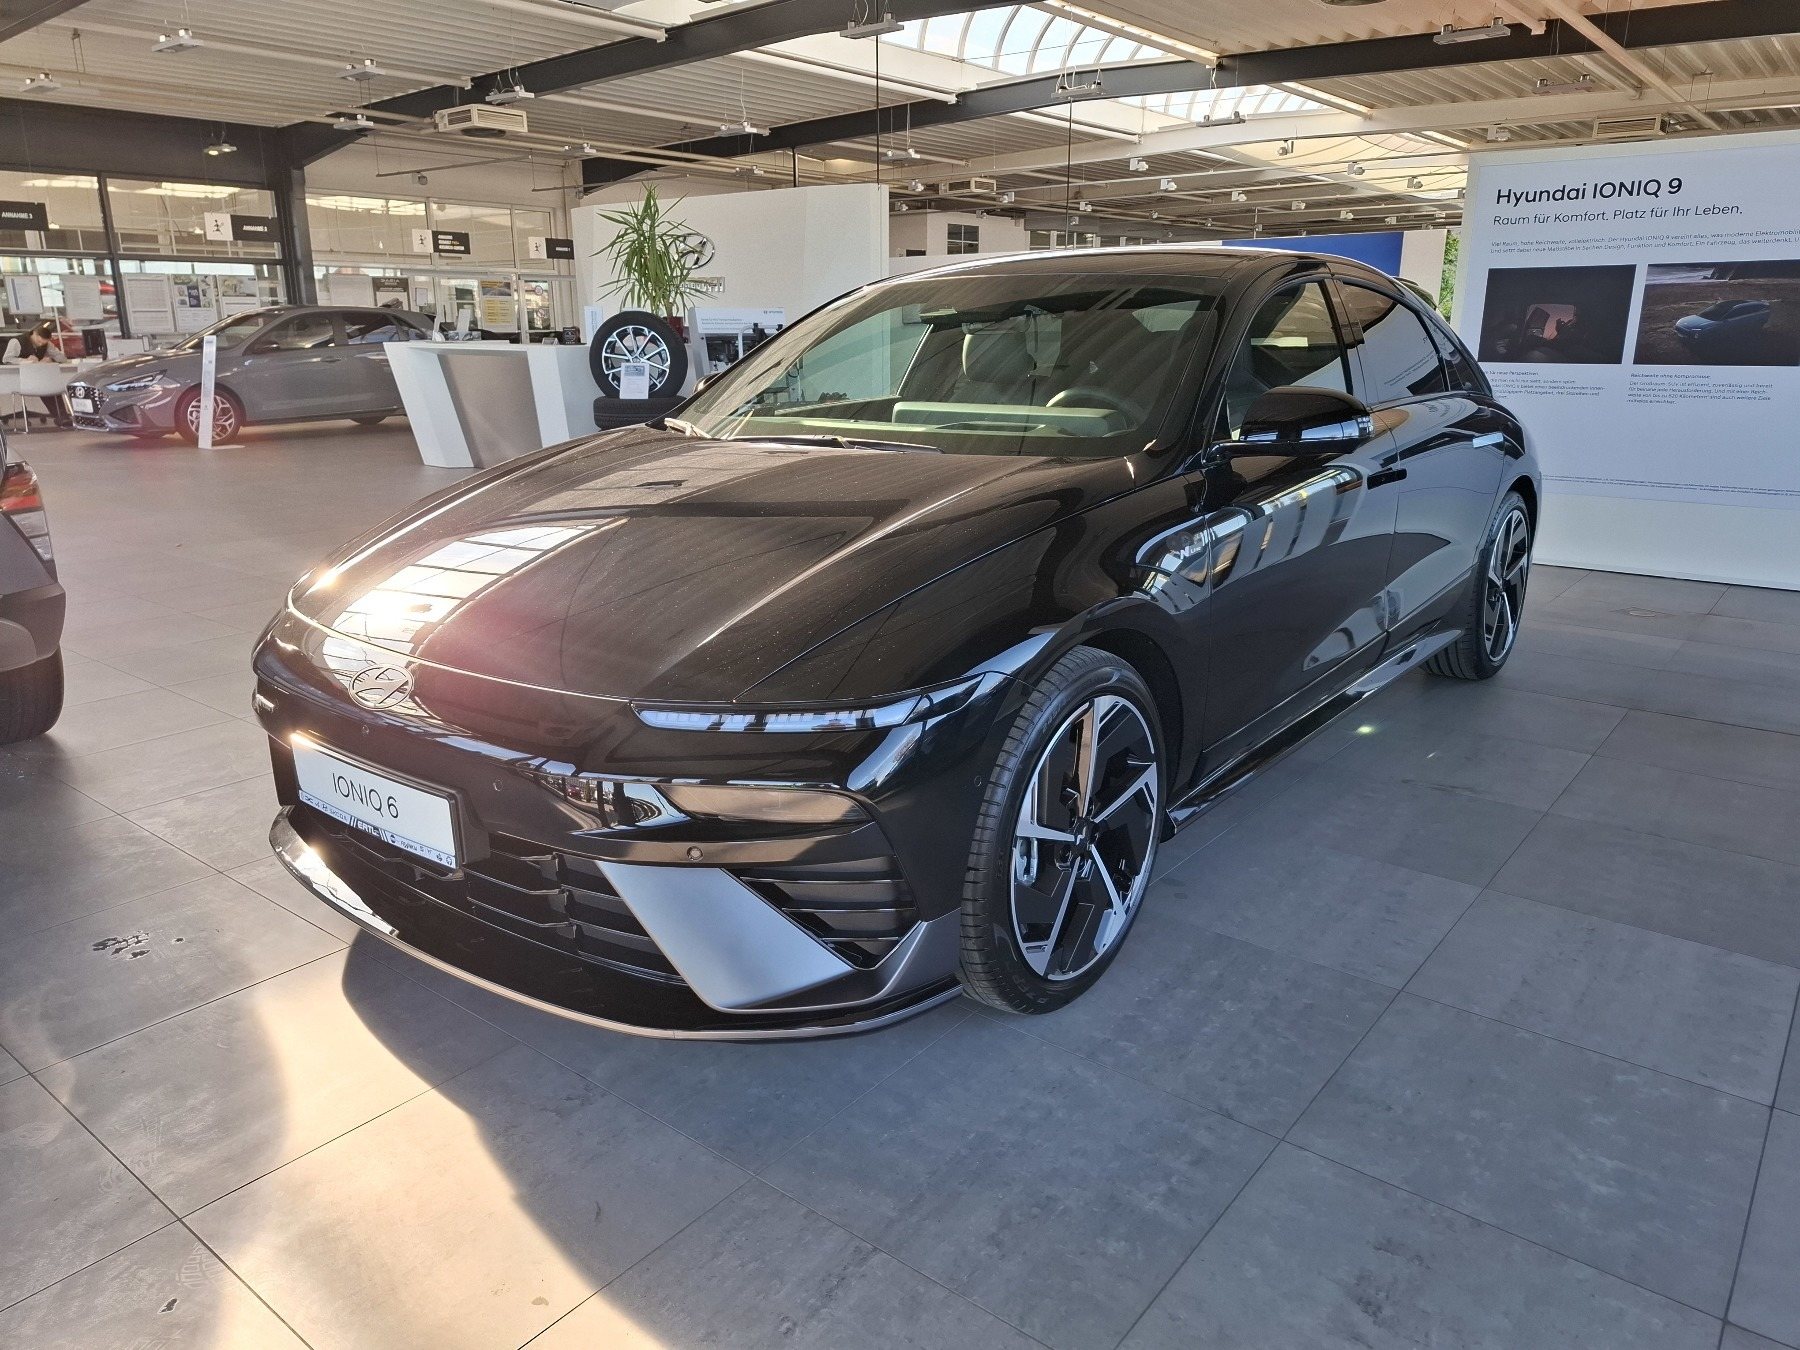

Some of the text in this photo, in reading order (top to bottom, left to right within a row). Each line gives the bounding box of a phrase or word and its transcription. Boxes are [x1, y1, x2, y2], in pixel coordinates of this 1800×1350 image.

[1496, 177, 1683, 207] Hyundai IONIQ 9
[1493, 204, 1743, 226] Raum für Komfort. Platz für Ihr Leben.
[332, 772, 399, 819] IONIQ 6
